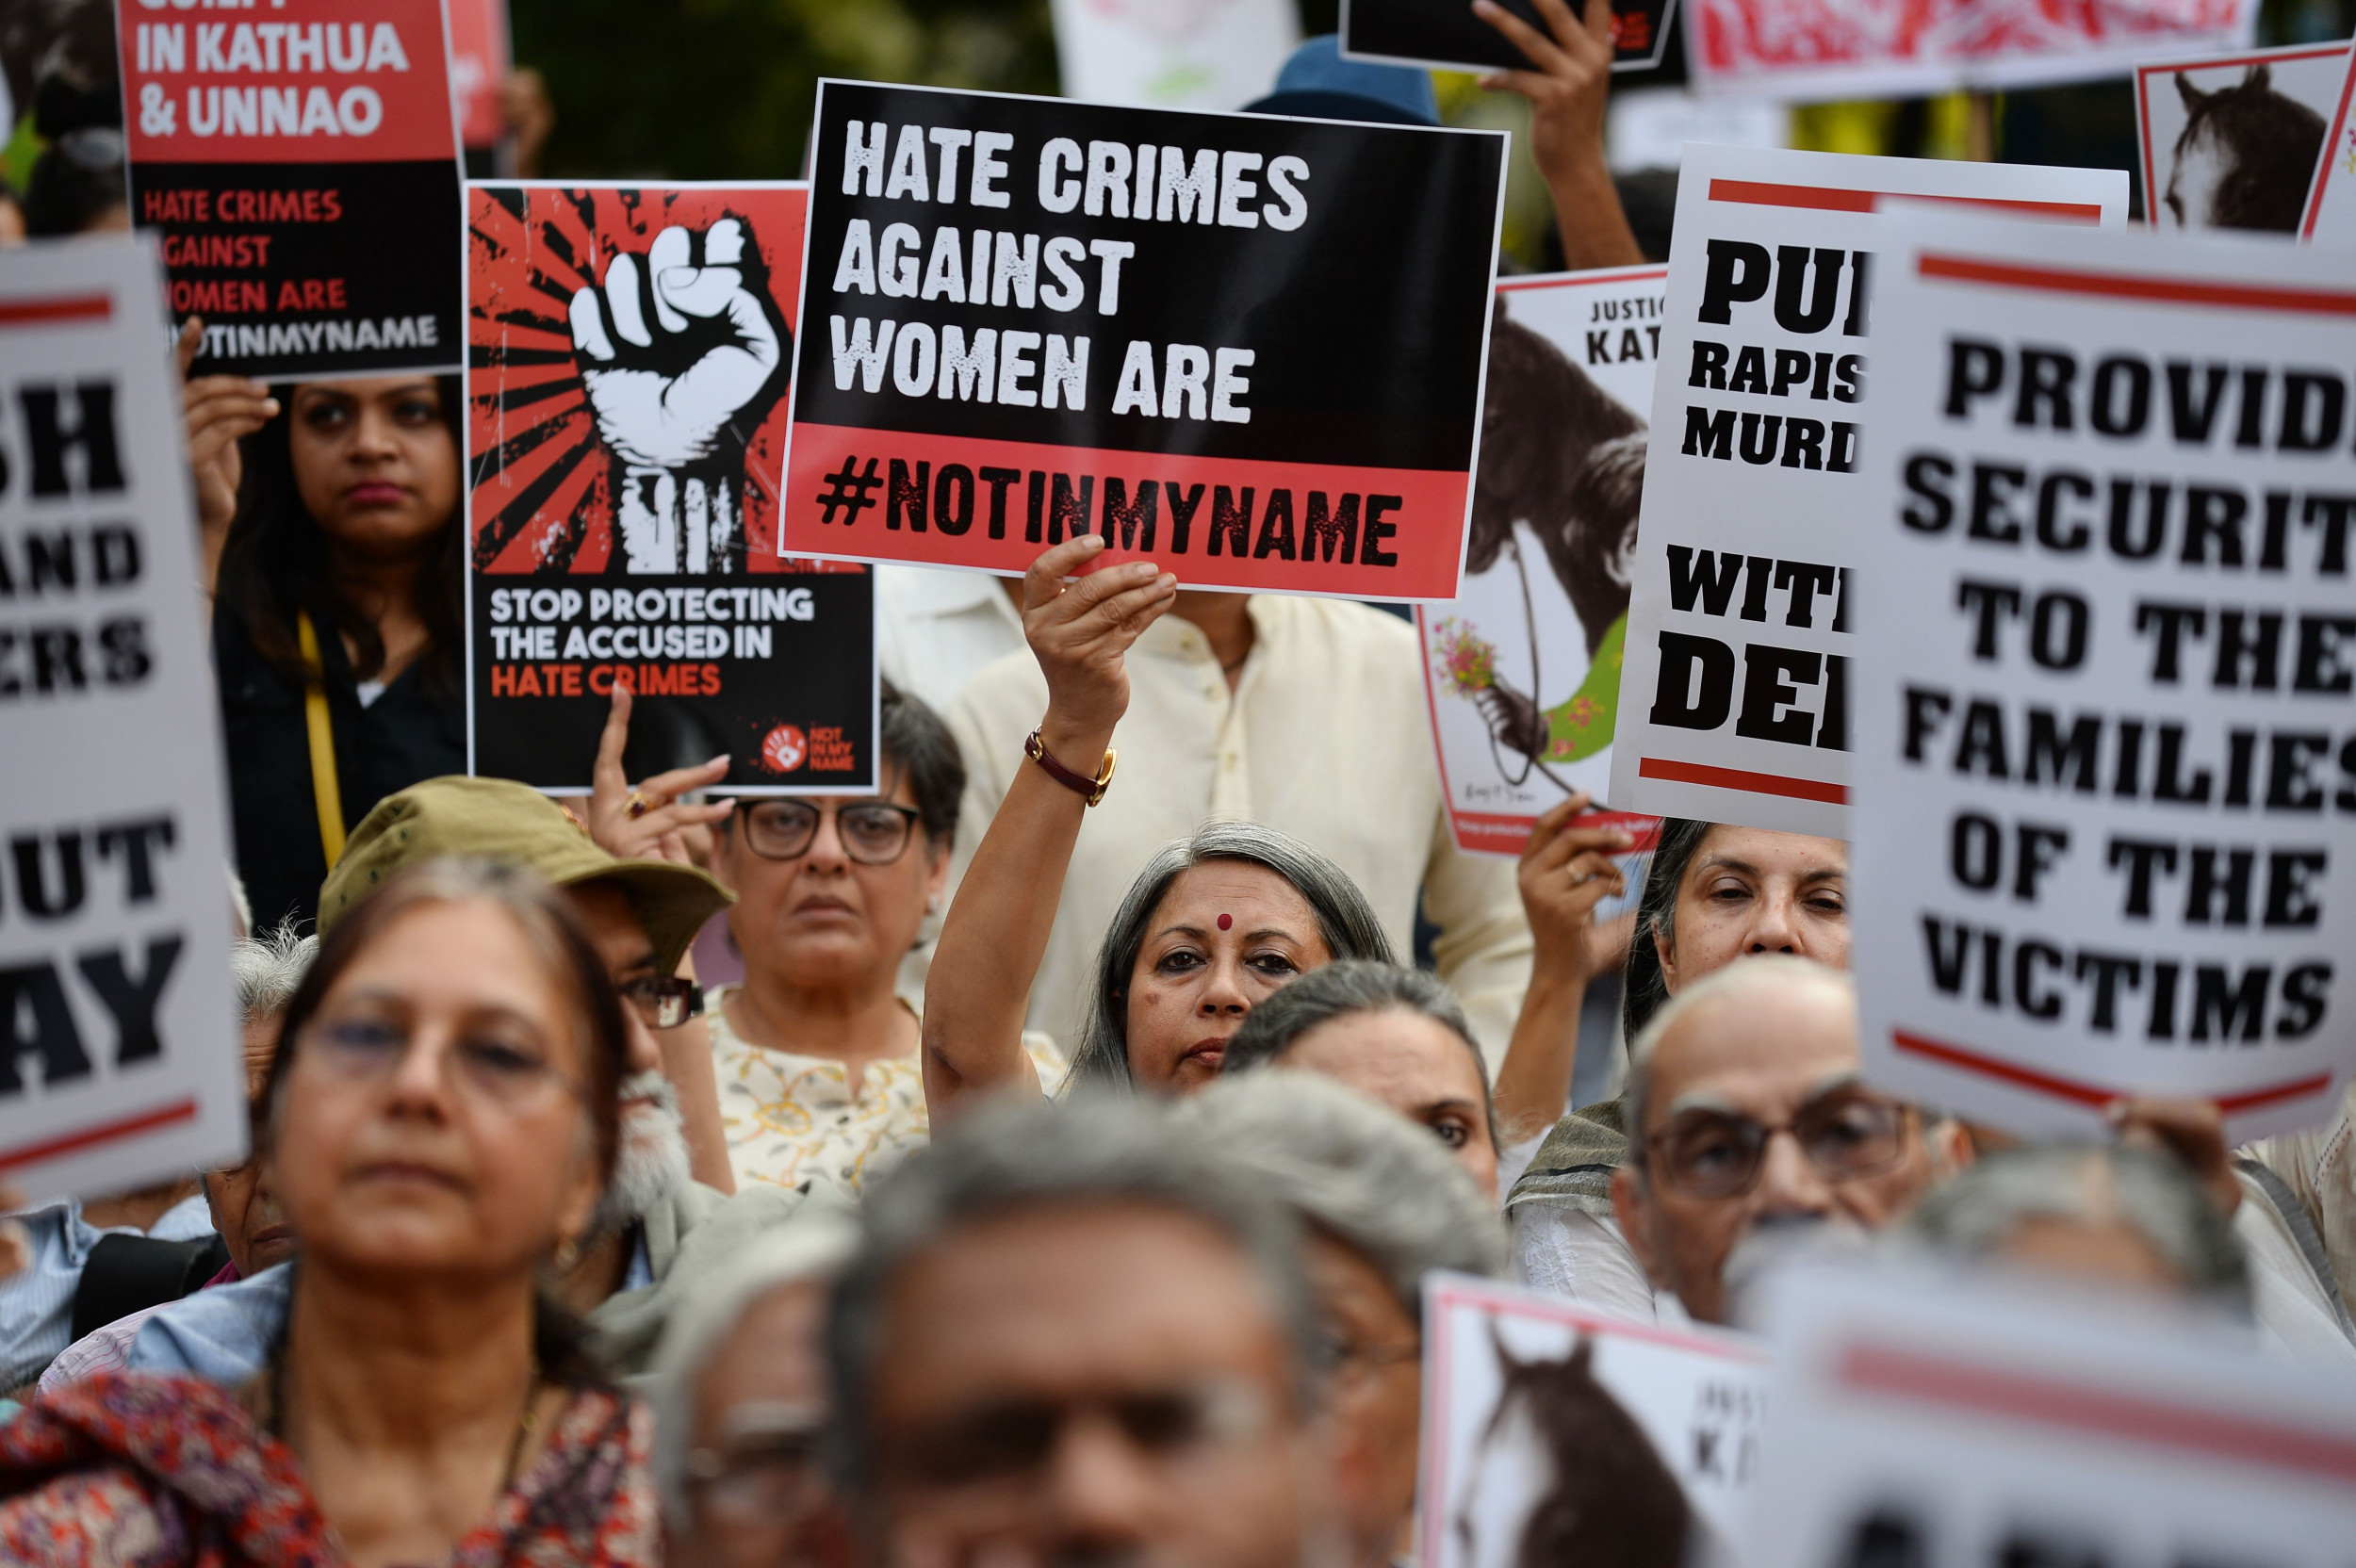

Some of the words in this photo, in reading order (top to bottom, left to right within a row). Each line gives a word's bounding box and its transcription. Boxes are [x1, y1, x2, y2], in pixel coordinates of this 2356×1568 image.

[137, 22, 186, 73] IN
[196, 22, 409, 73] KATHUA
[139, 83, 178, 138] &
[188, 86, 384, 137] UNNAO
[144, 189, 210, 221] HATE
[217, 189, 343, 222] CRIMES
[843, 120, 1014, 209] HATE
[1037, 137, 1310, 232] CRIMES
[277, 279, 347, 311] ARE
[832, 219, 1135, 316] AGAINST
[830, 315, 1090, 412] WOMEN
[1111, 340, 1255, 425] ARE
[1944, 335, 2356, 461] PROVID
[816, 455, 1403, 567] #NOTINMYNAME
[1899, 450, 2356, 576] SECURIT
[490, 588, 582, 622] STOP
[590, 587, 814, 621] PROTECTING
[490, 627, 558, 660] THE
[563, 626, 729, 659] ACCUSED
[734, 626, 772, 659] IN
[1957, 578, 2089, 673] TO
[2135, 600, 2356, 695] THE
[491, 664, 582, 696] HATE
[588, 663, 722, 696] CRIMES
[0, 815, 176, 923] UT
[1949, 809, 2070, 903] OF
[2107, 836, 2330, 929] THE
[1922, 912, 2334, 1045] VICTIMS
